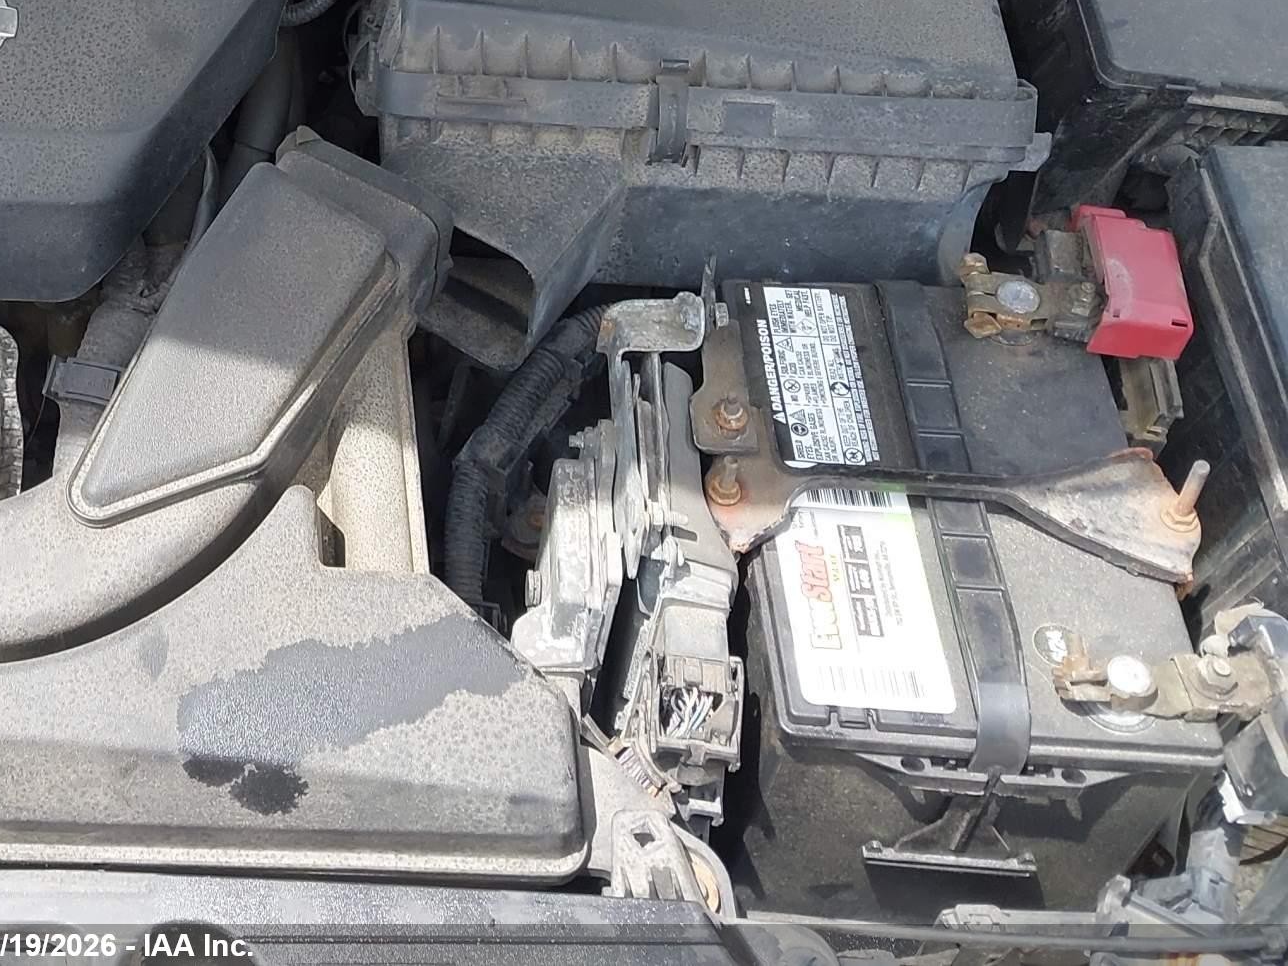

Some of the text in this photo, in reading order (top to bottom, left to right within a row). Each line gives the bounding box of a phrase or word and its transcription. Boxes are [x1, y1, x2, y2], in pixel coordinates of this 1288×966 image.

[793, 290, 803, 312] MEDICAL
[769, 303, 781, 333] FLUSH EYES
[776, 300, 788, 333] IMMEDIATELY
[804, 305, 812, 317] HELP
[817, 312, 826, 324] OPEN
[788, 321, 797, 333] WITH
[820, 324, 828, 334] NOT
[756, 318, 784, 412] DANGER/POISON
[778, 349, 789, 375] SULFURIC
[789, 363, 797, 375] ACID
[797, 366, 805, 375] CAN
[803, 350, 813, 376] BLINDNESS
[813, 359, 822, 376] SEVERE
[816, 408, 827, 434] BLINDNESS
[808, 412, 824, 460] EXPLOSIVE GASES
[821, 435, 830, 450] CAUSE
[795, 440, 805, 459] SHIELD
